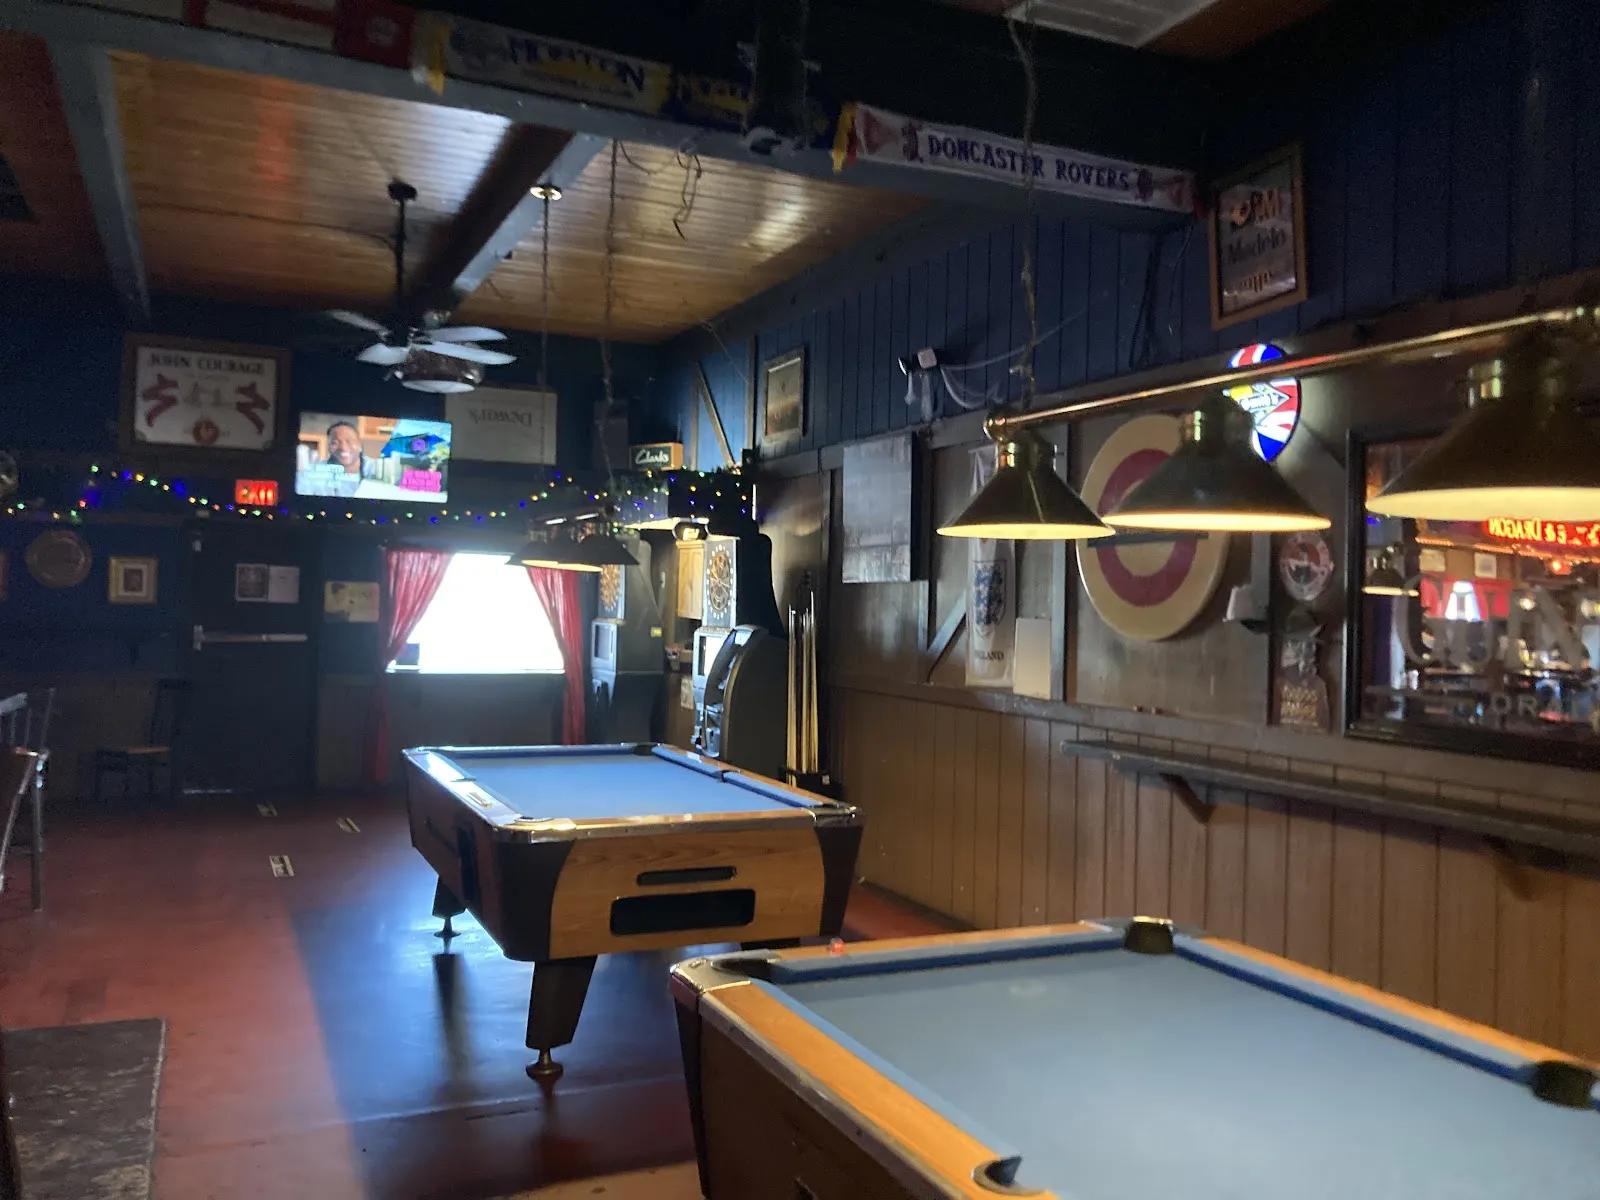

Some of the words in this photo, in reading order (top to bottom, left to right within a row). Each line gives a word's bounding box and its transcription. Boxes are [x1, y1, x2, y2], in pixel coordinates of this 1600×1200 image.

[928, 134, 1046, 178] DONCASTER
[1056, 158, 1132, 193] ROVERS
[151, 353, 190, 368] JOHN
[197, 357, 265, 376] COURAGE
